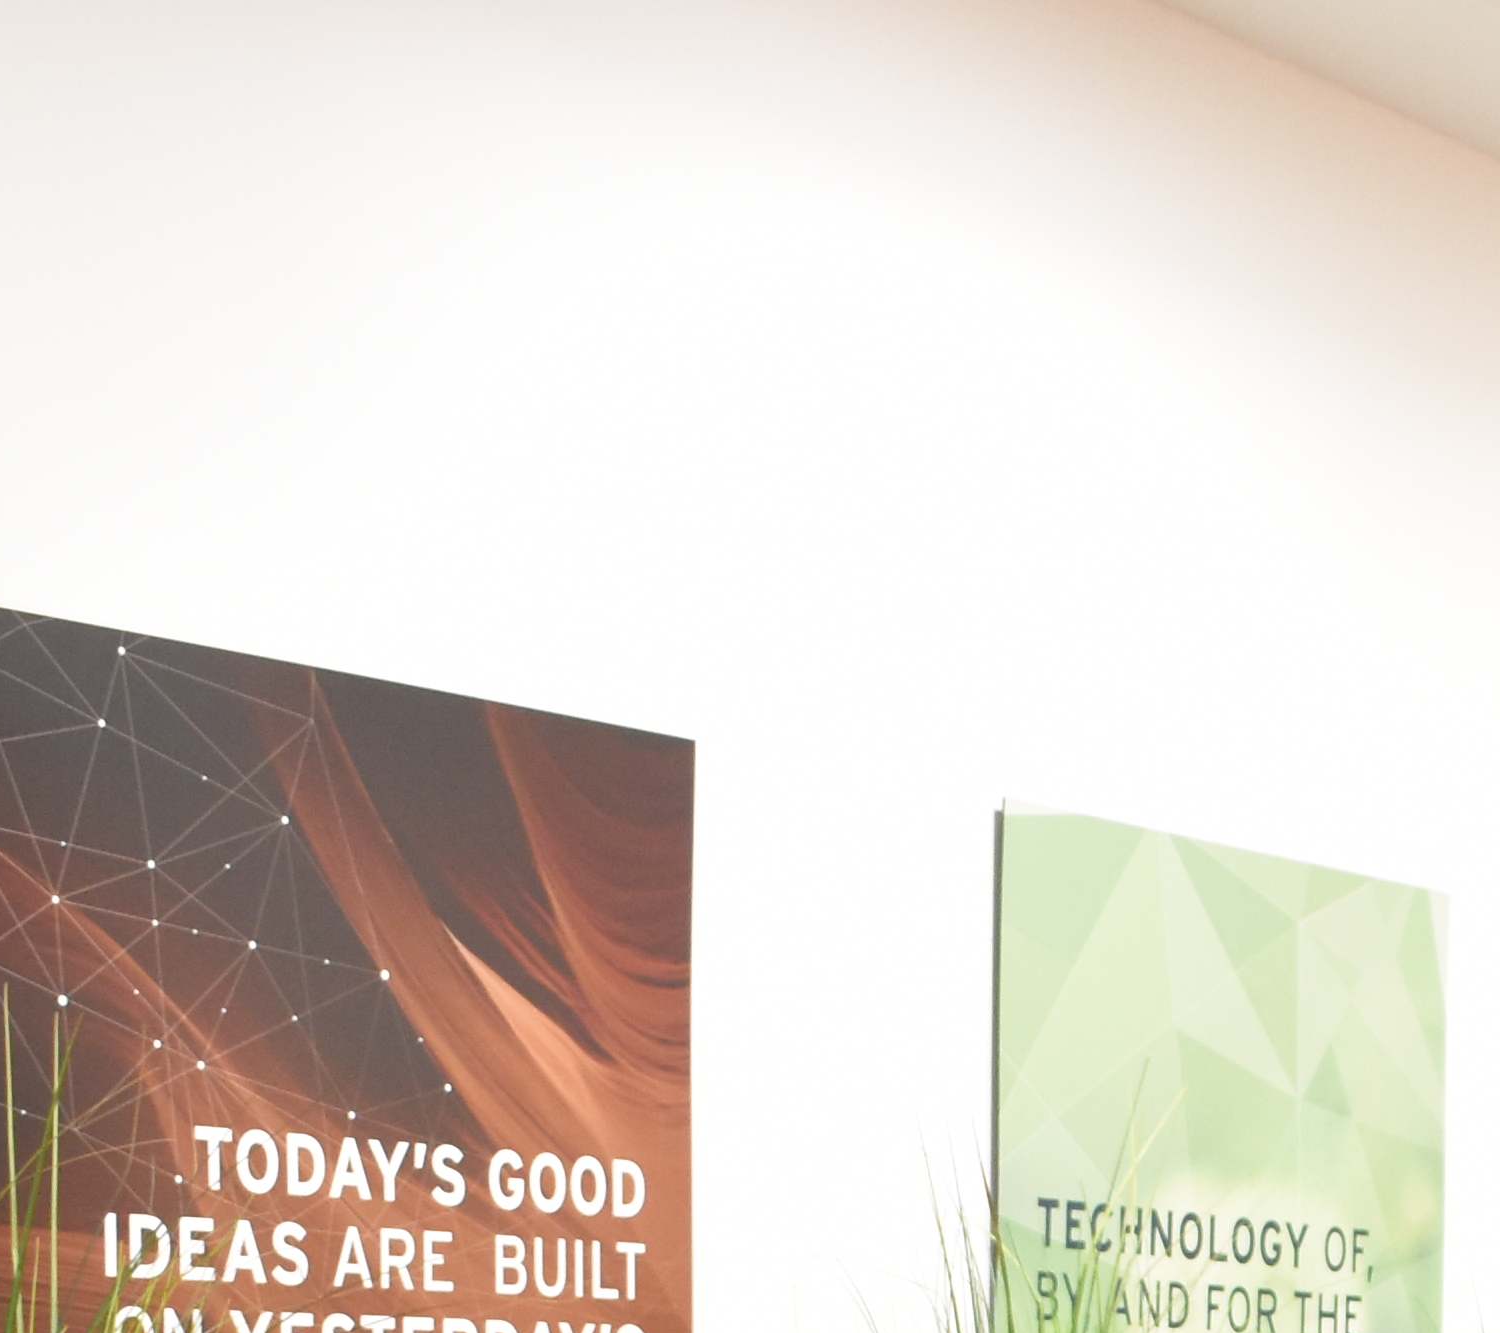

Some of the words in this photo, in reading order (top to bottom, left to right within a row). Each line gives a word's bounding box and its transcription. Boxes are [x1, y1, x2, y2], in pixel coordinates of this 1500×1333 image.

[193, 1124, 467, 1207] TODAY'S
[488, 1148, 646, 1219] GOOD
[103, 1211, 309, 1288] IDEAS
[332, 1224, 455, 1292] ARE
[494, 1233, 647, 1301] BUILT
[1037, 1197, 1309, 1269] TECHNOLOGY
[1324, 1225, 1375, 1284] OF,
[1037, 1271, 1082, 1322] BY
[1113, 1277, 1191, 1330] AND
